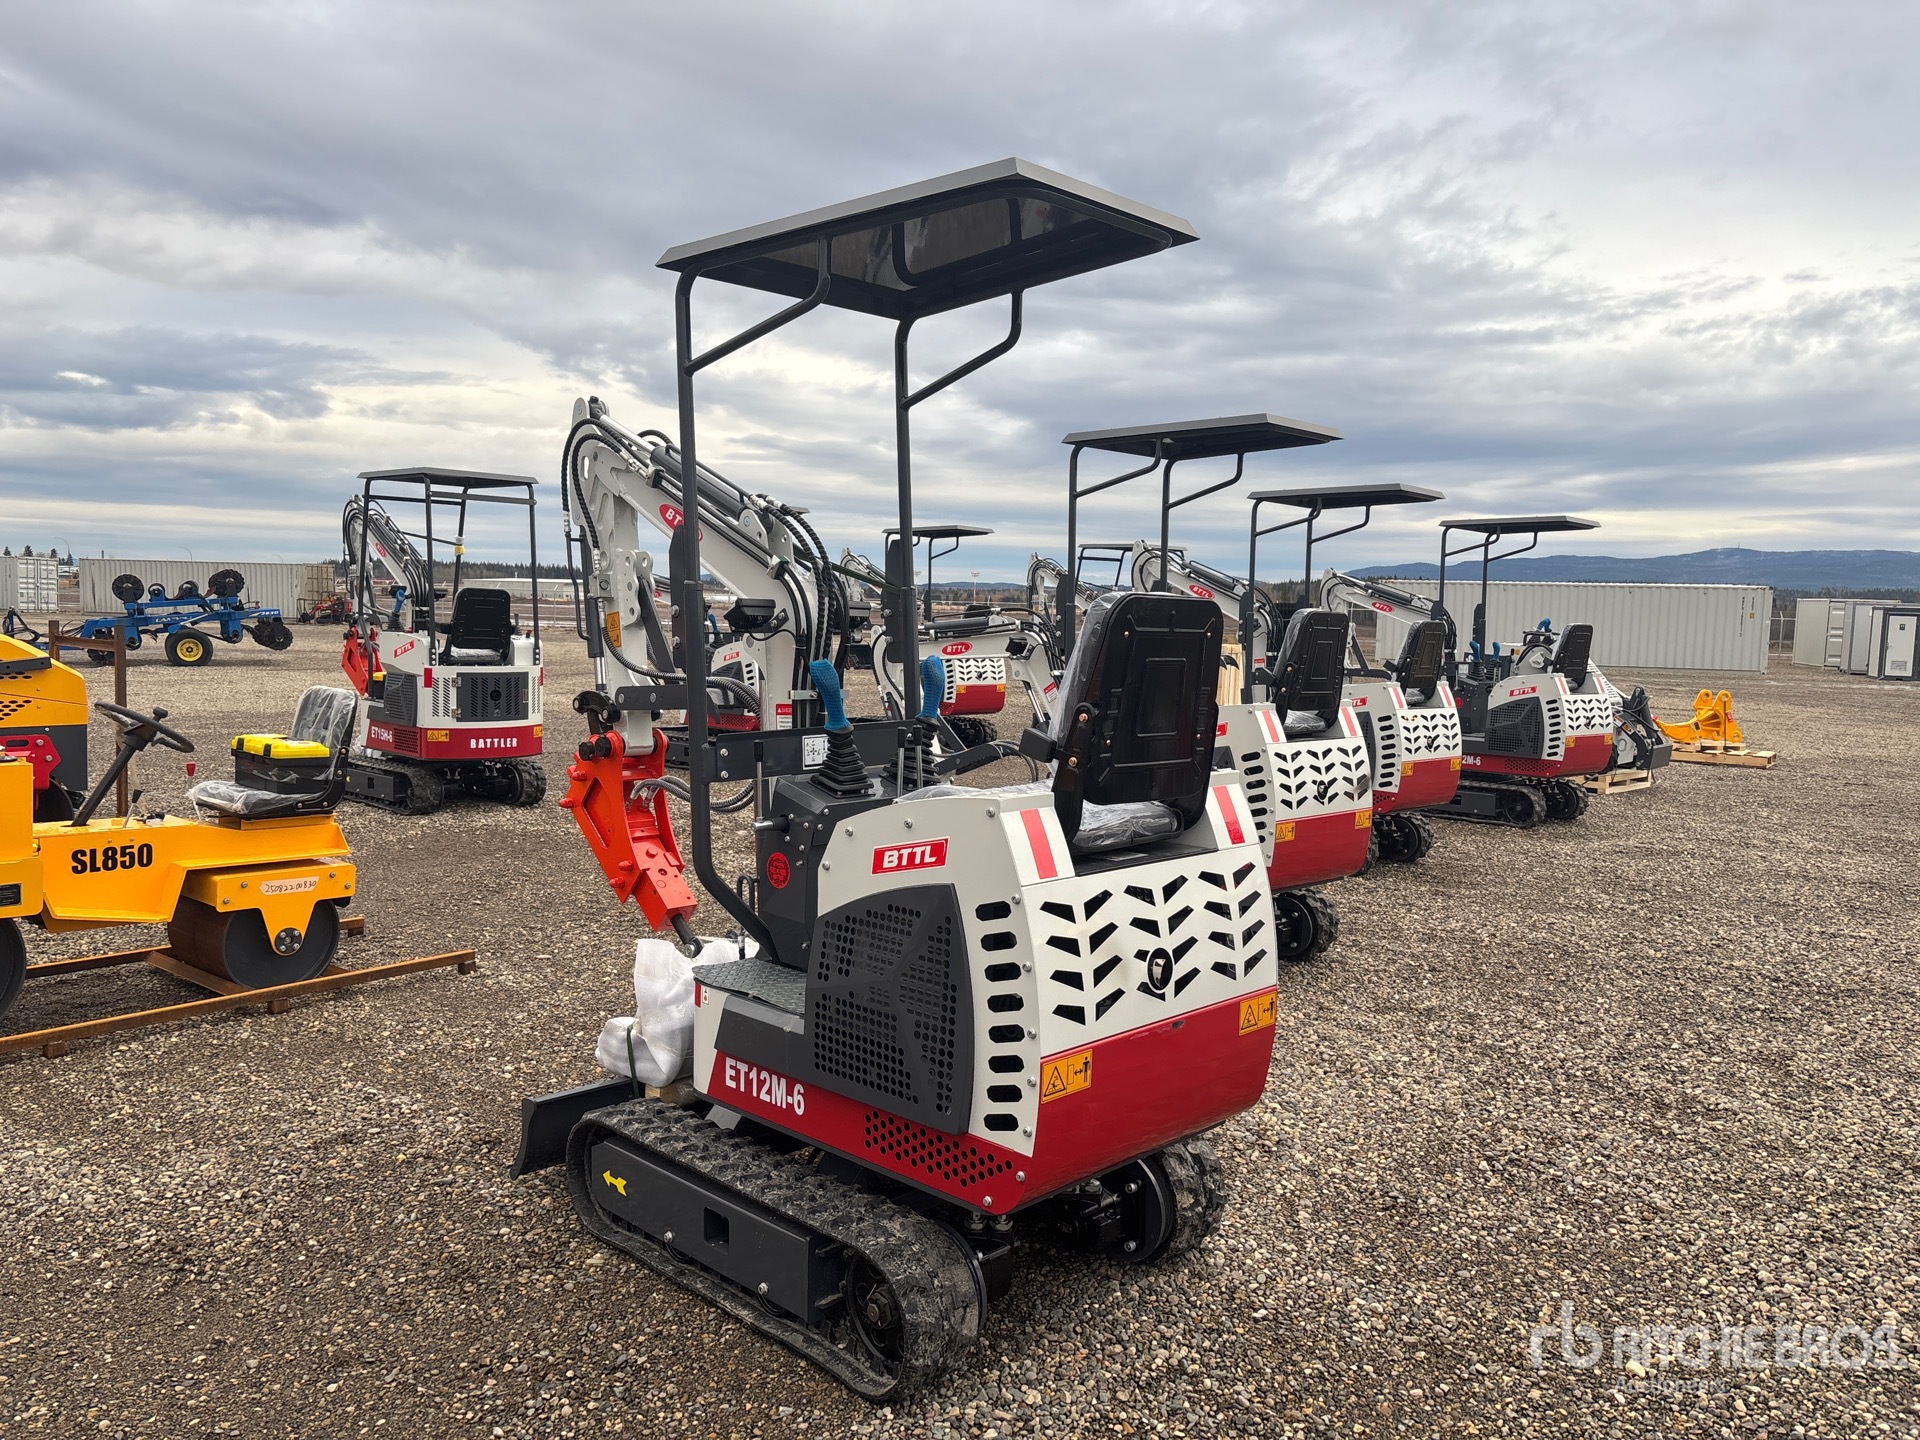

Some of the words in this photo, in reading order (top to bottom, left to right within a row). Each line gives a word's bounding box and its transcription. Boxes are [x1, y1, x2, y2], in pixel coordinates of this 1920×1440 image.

[1192, 586, 1210, 599] BTTL
[1375, 603, 1390, 612] BTTL
[396, 643, 413, 656] BTTL
[947, 644, 967, 653] BTTL
[1513, 687, 1533, 696] BTTL
[470, 737, 518, 749] BATTLER
[1461, 754, 1481, 766] 2M-6
[71, 843, 153, 875] SL850
[883, 845, 938, 869] BTTL
[725, 1056, 805, 1116] ET12M-6
